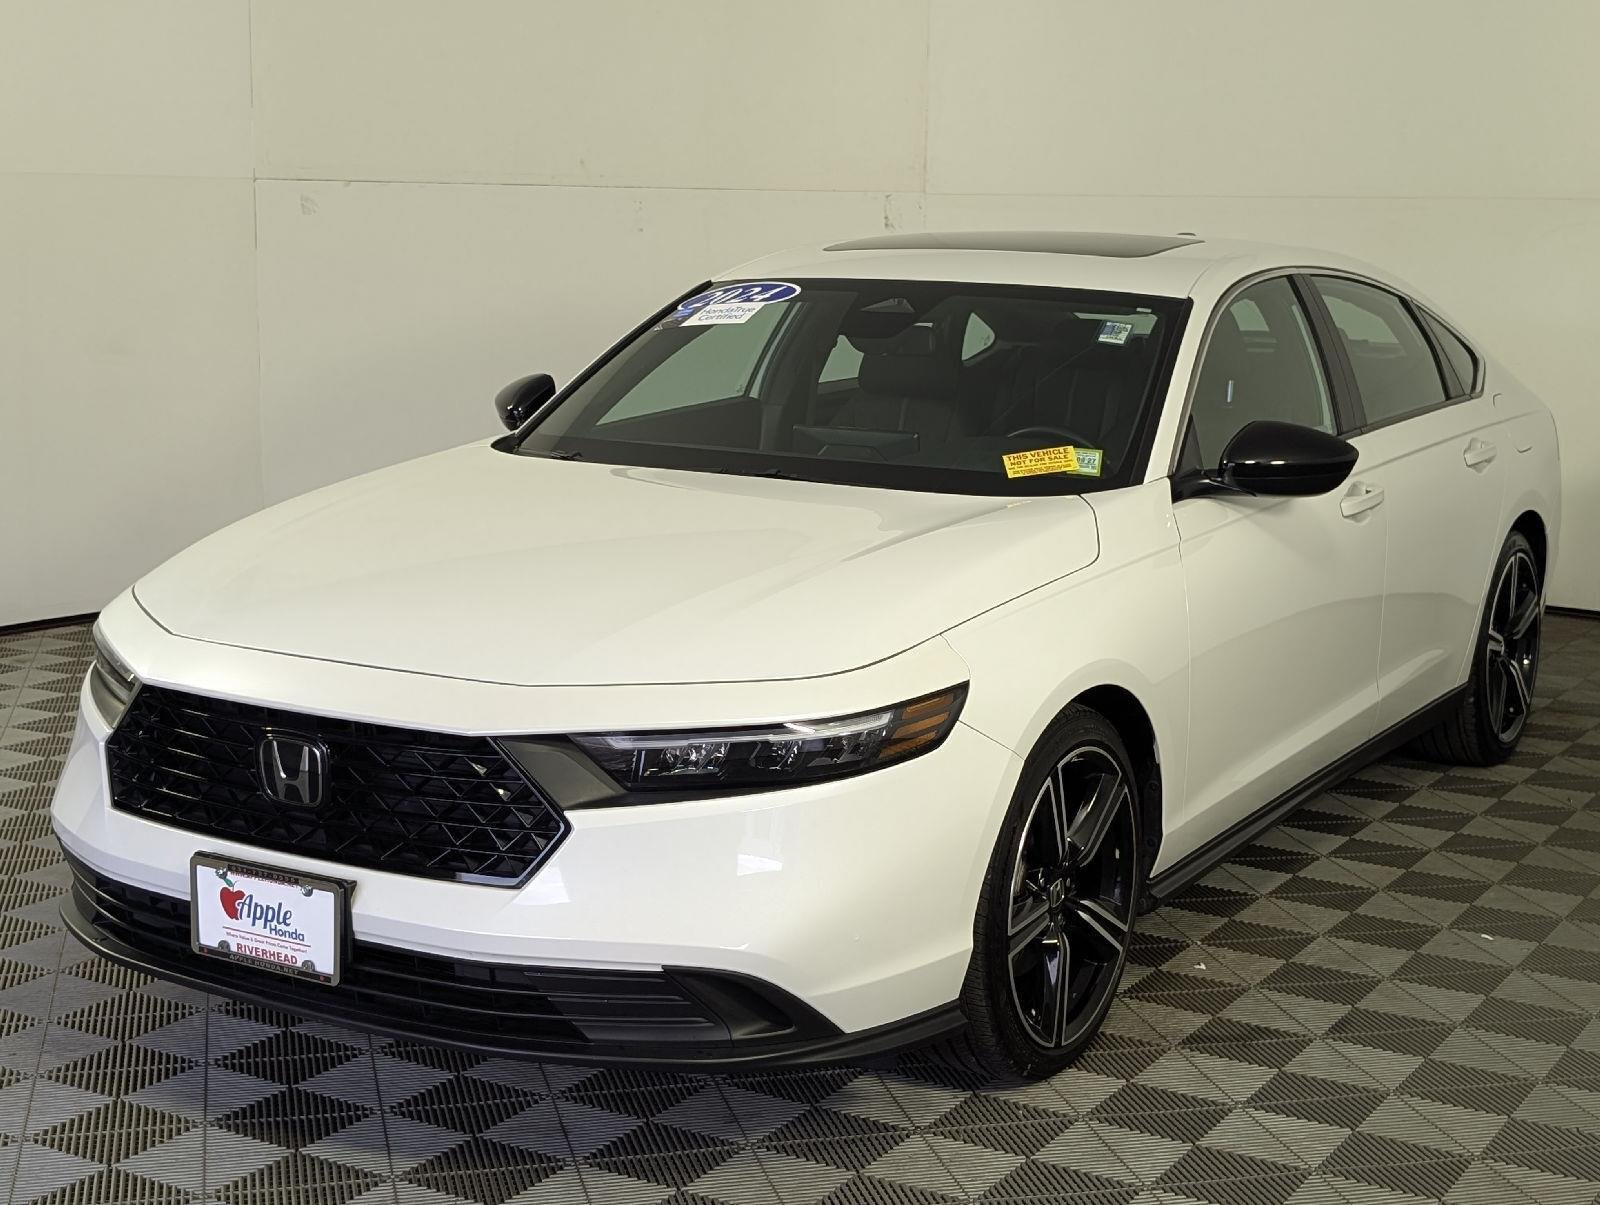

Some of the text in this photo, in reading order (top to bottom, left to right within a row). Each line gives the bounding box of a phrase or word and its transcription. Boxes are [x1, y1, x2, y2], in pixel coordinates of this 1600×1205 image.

[688, 285, 788, 308] 2024
[698, 313, 746, 321] Certified
[1007, 447, 1069, 462] THIS VEHICLE
[1010, 459, 1028, 467] NOT
[1047, 454, 1069, 462] SALE
[237, 894, 292, 929] Apple
[269, 924, 305, 942] Honda
[236, 942, 298, 965] RIVERHEAD
